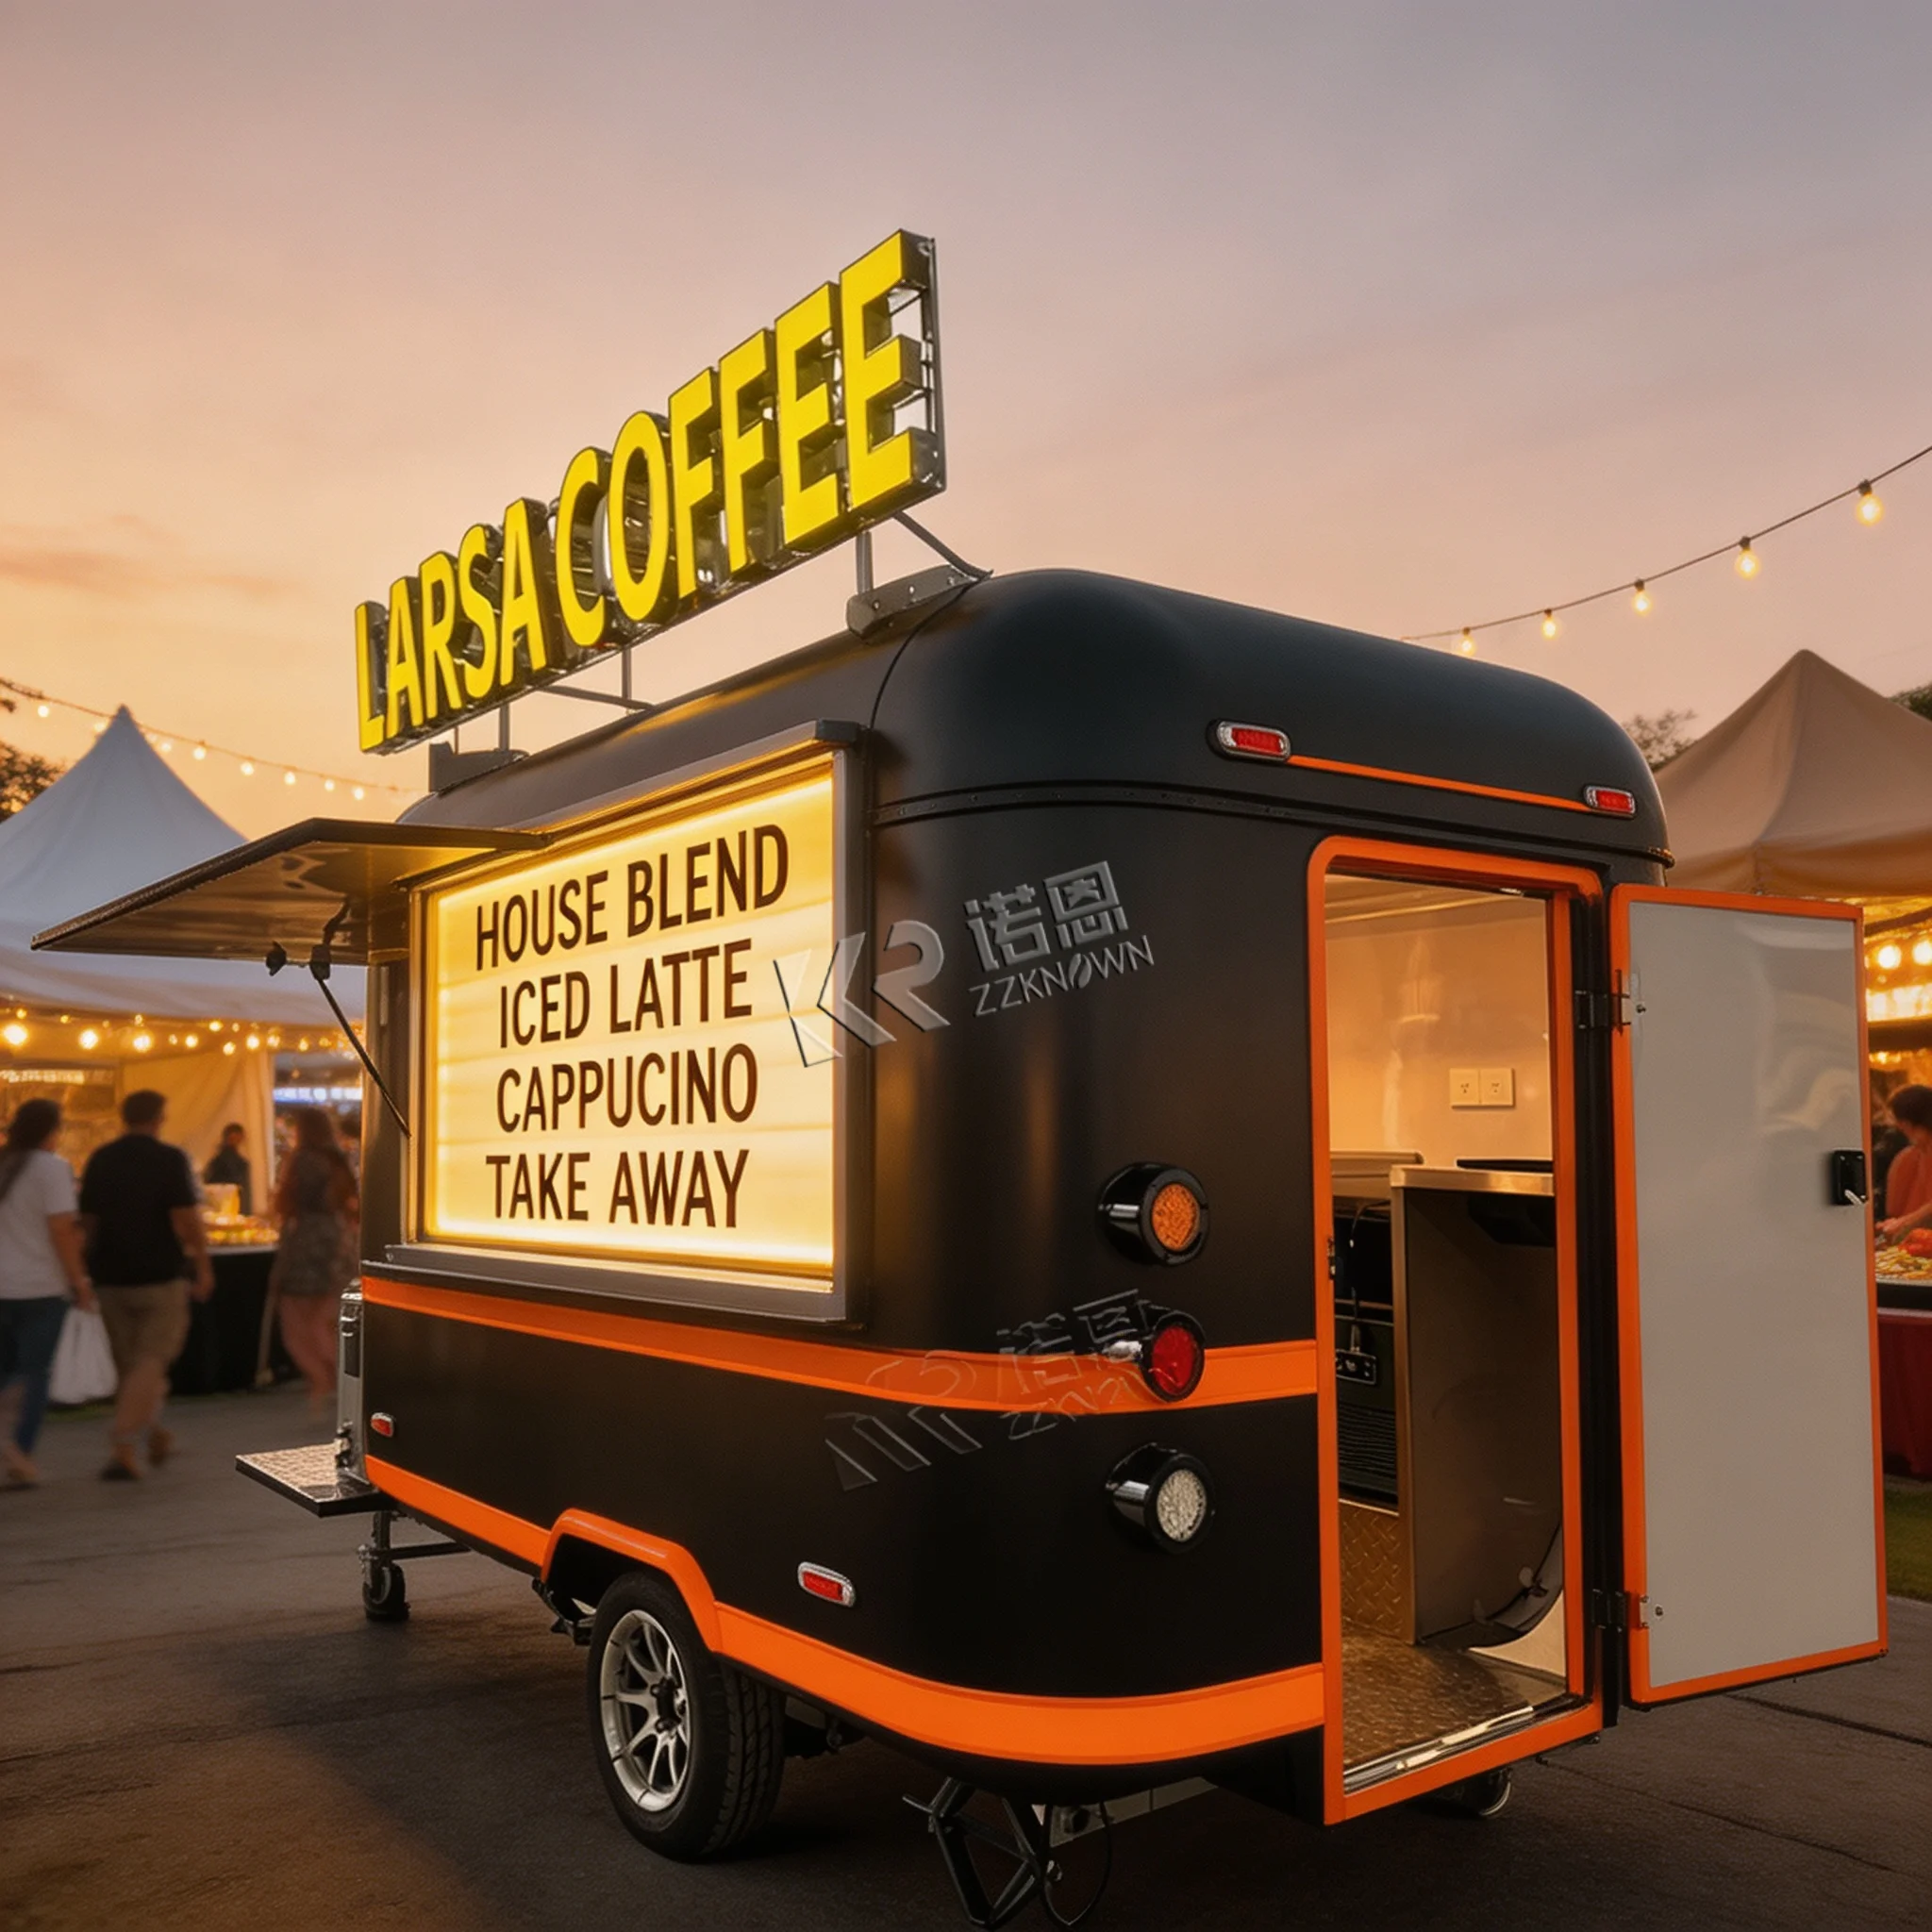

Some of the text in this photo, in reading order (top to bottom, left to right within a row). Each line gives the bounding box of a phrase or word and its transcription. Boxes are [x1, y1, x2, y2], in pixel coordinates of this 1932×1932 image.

[355, 229, 917, 754] LARSA COFFEE
[476, 824, 789, 971] HOUSE BLEND
[500, 939, 752, 1048] ICED LATTE
[496, 1042, 756, 1133] CAPPUCINO
[486, 1149, 749, 1228] TAKE AWAY
